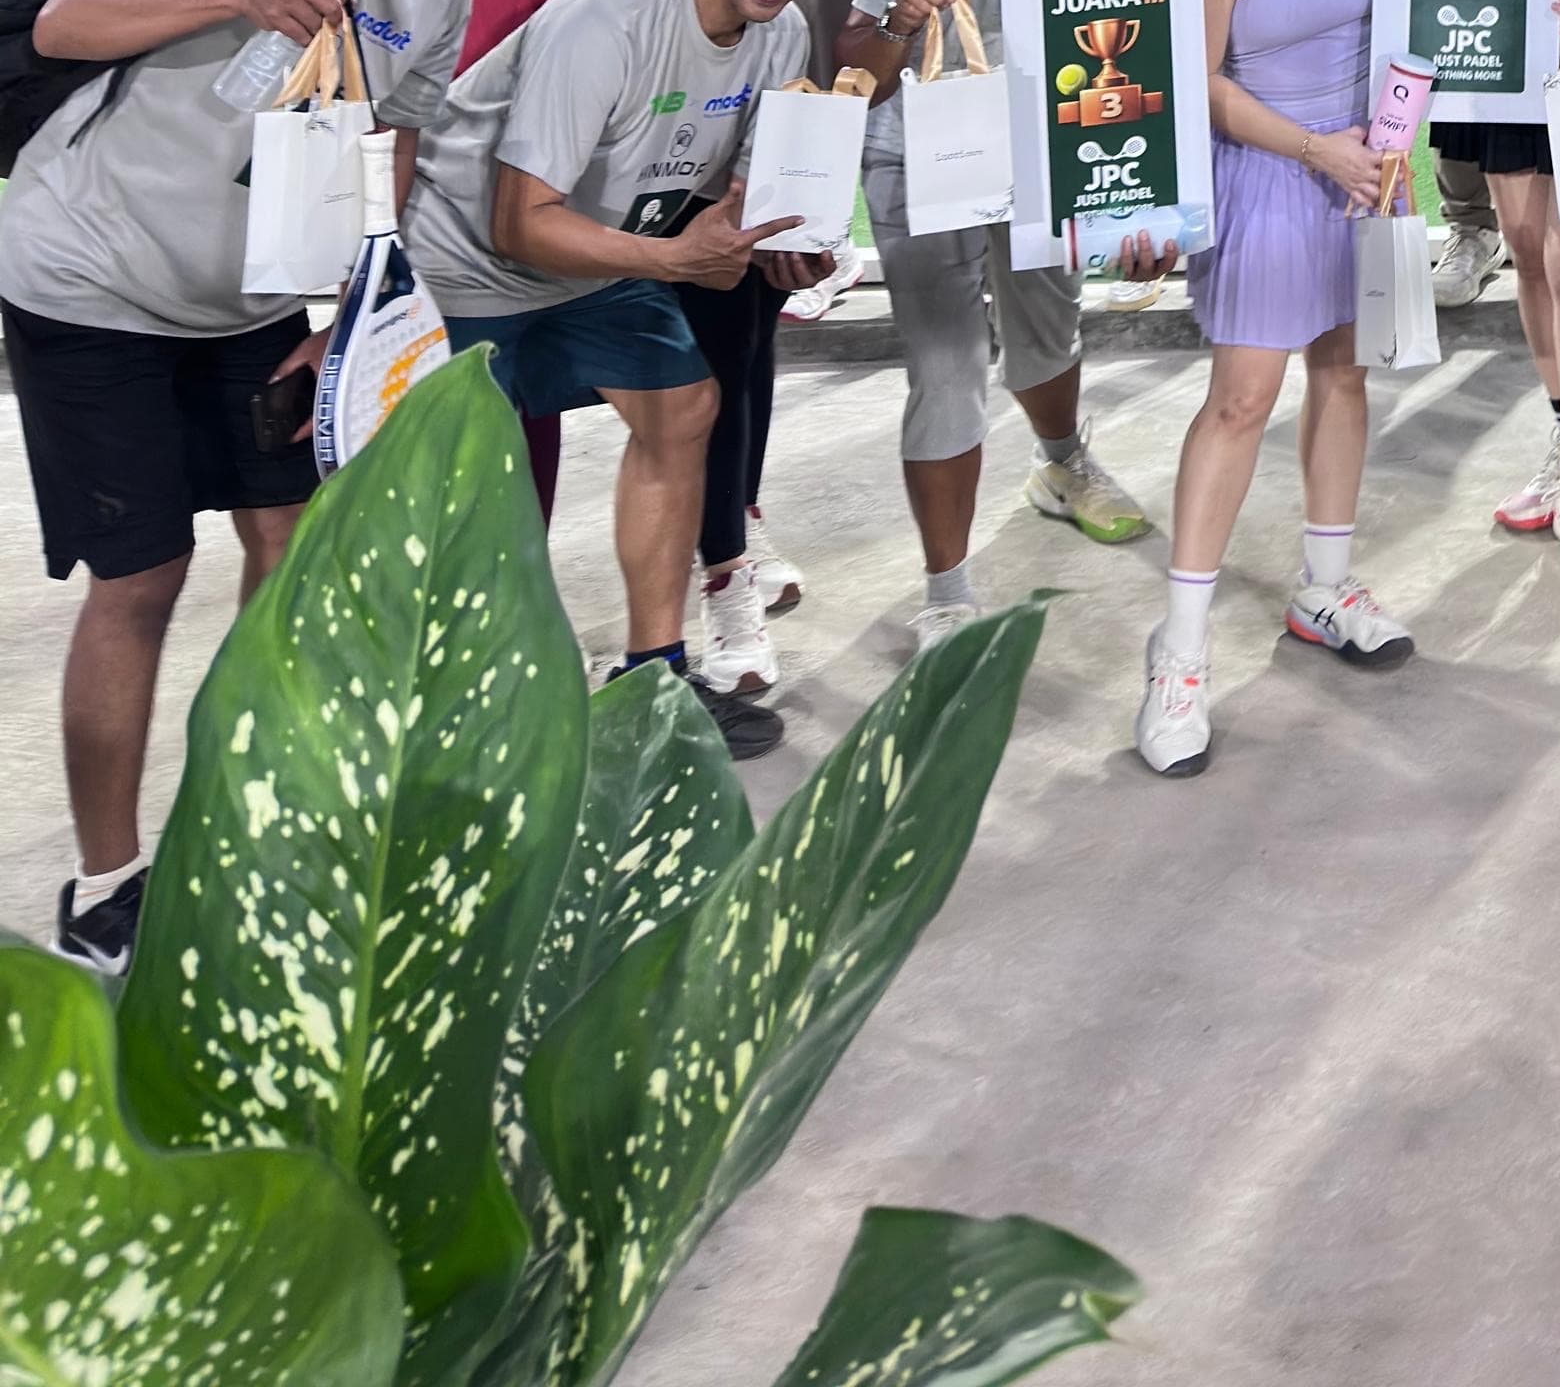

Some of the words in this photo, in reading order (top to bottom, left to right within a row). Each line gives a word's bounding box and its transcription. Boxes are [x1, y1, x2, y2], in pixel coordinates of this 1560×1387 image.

[1440, 30, 1492, 54] JPC
[1433, 54, 1461, 67] JUST
[1463, 54, 1504, 68] PADEL
[1436, 69, 1473, 81] OTHING
[1474, 70, 1503, 81] MORE
[1100, 92, 1123, 119] 3
[1083, 161, 1142, 191] JPC
[1073, 192, 1108, 208] JUST
[1109, 186, 1156, 204] PADEL
